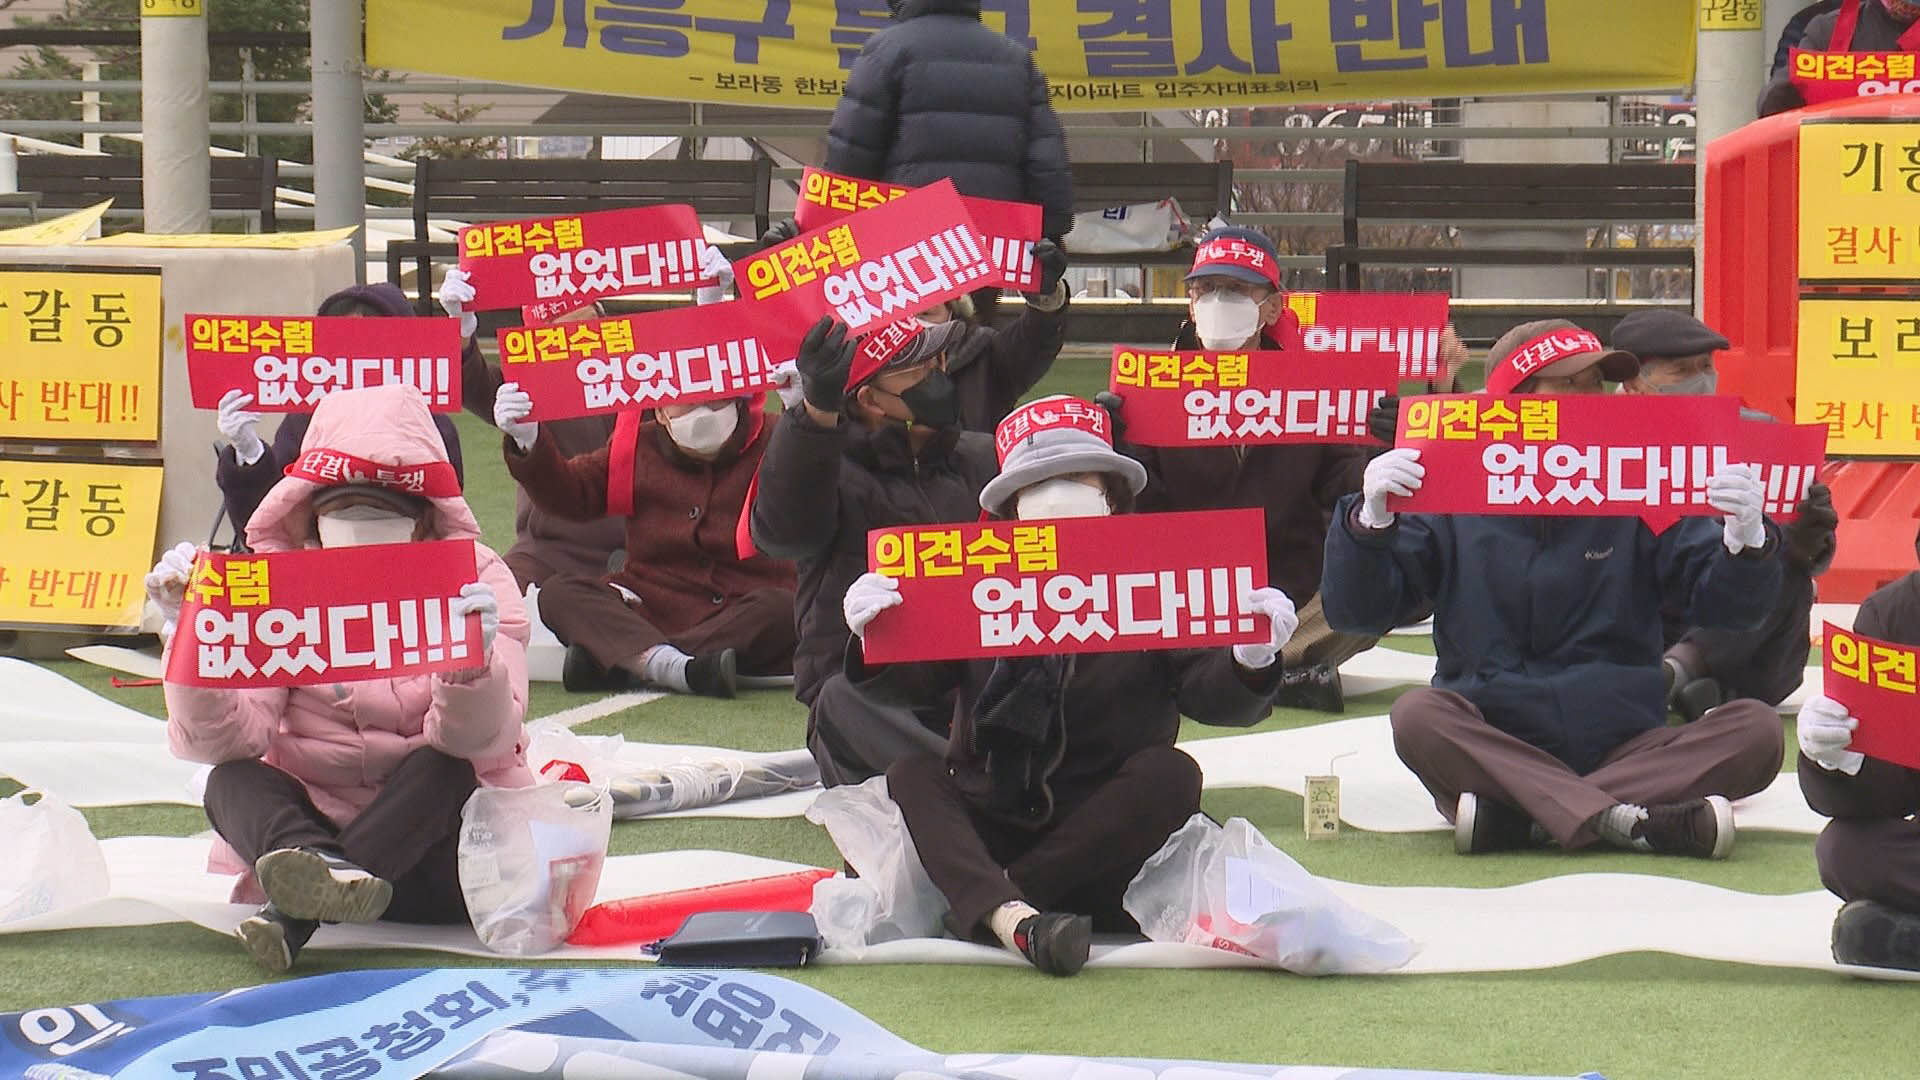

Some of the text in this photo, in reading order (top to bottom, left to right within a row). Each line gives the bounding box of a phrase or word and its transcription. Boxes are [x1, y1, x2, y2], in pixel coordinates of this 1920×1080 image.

[1329, 0, 1549, 73] 반대
[715, 72, 783, 95] 보라동
[794, 76, 848, 96] 한보
[1155, 80, 1319, 99] 입주자대표회의
[1796, 54, 1915, 80] 의견수렴
[465, 218, 583, 258] 의견수렴
[1828, 226, 1902, 264] 결사
[747, 223, 861, 301] 의견수렴
[824, 223, 991, 329] 없었다!!!
[0, 288, 131, 347] 갈동
[192, 319, 313, 353] 의견수렴
[506, 319, 634, 363] 의견수렴
[863, 322, 908, 360] 단결
[1512, 338, 1559, 374] 단결
[1117, 352, 1248, 388] 의견수렴
[41, 381, 139, 423] 반대!!
[1405, 400, 1558, 441] 의견수렴
[998, 403, 1104, 454] 단결 투쟁
[302, 452, 425, 492] 단결 투쟁
[875, 525, 1059, 577] 의견수렴
[28, 569, 129, 609] 반대!!
[185, 559, 270, 606] 수렴
[971, 566, 1255, 648] 없었다!!!
[194, 597, 469, 679] 없었다!!!
[1831, 633, 1920, 694] 의견
